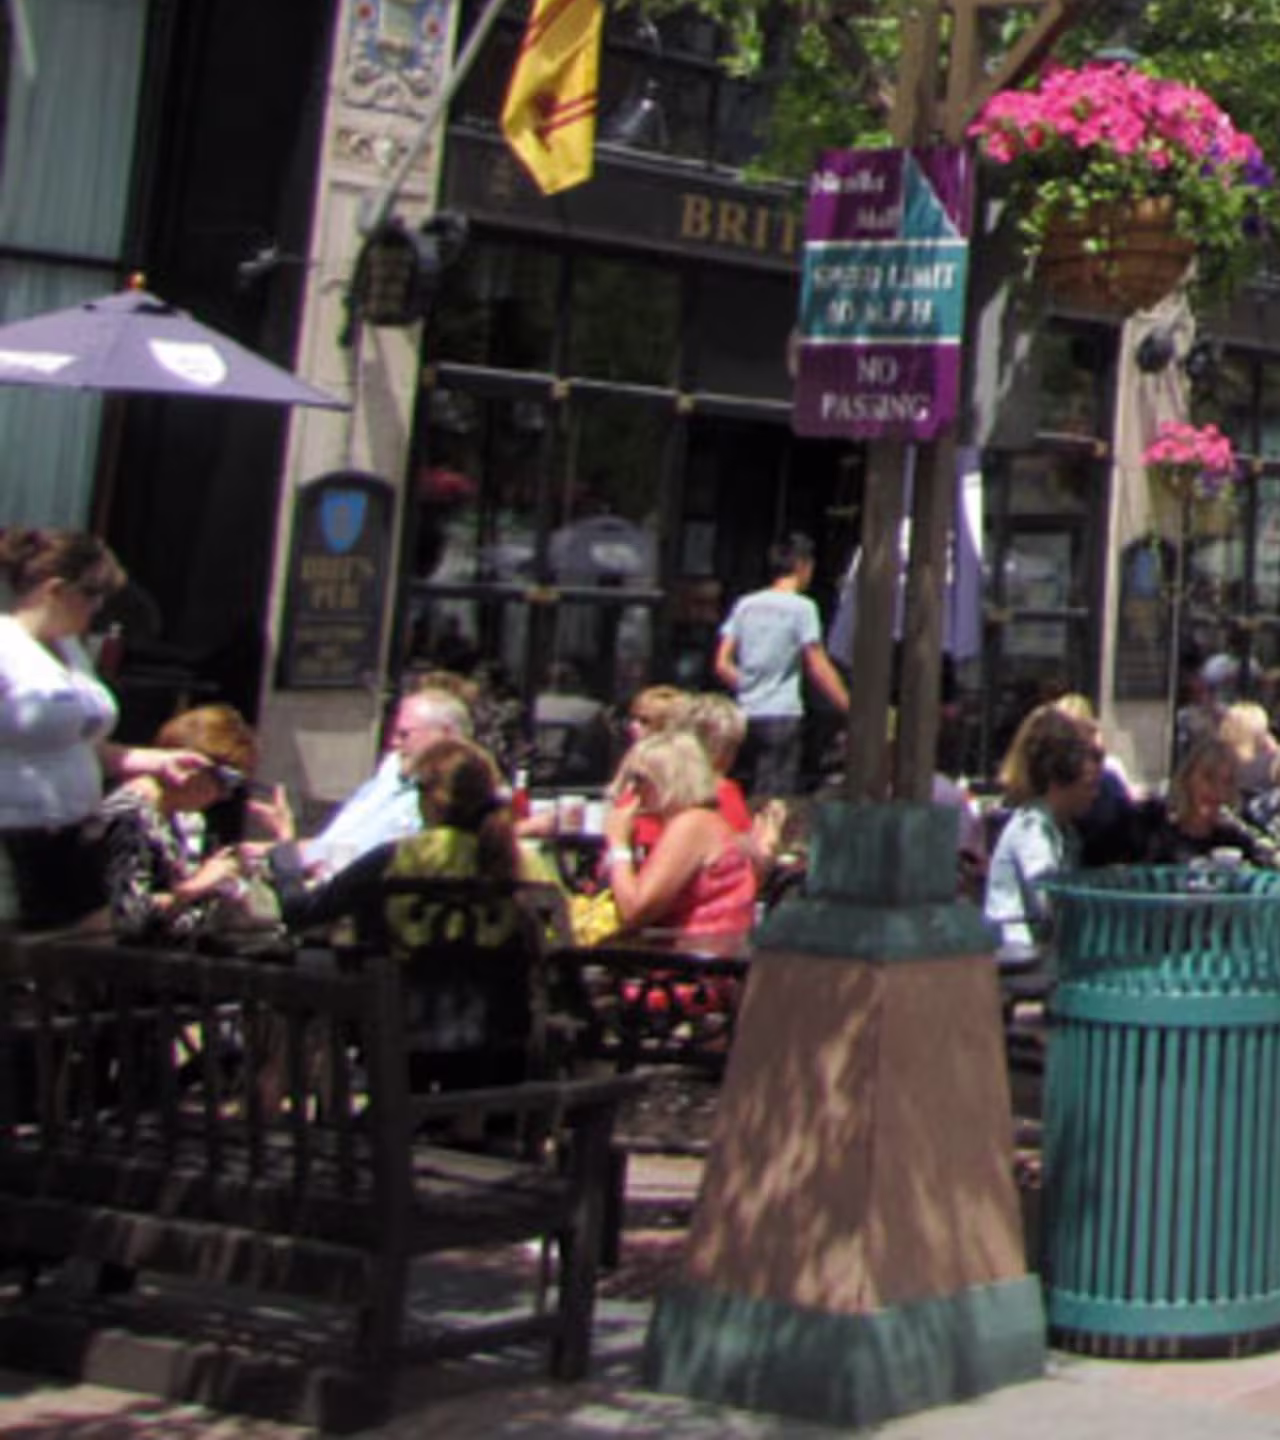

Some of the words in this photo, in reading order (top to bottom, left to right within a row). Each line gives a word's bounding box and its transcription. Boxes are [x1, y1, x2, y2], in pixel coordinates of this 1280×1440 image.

[814, 264, 883, 291] SPEED
[887, 261, 958, 289] LIMIT
[857, 355, 900, 385] NO
[820, 390, 931, 422] PASSING
